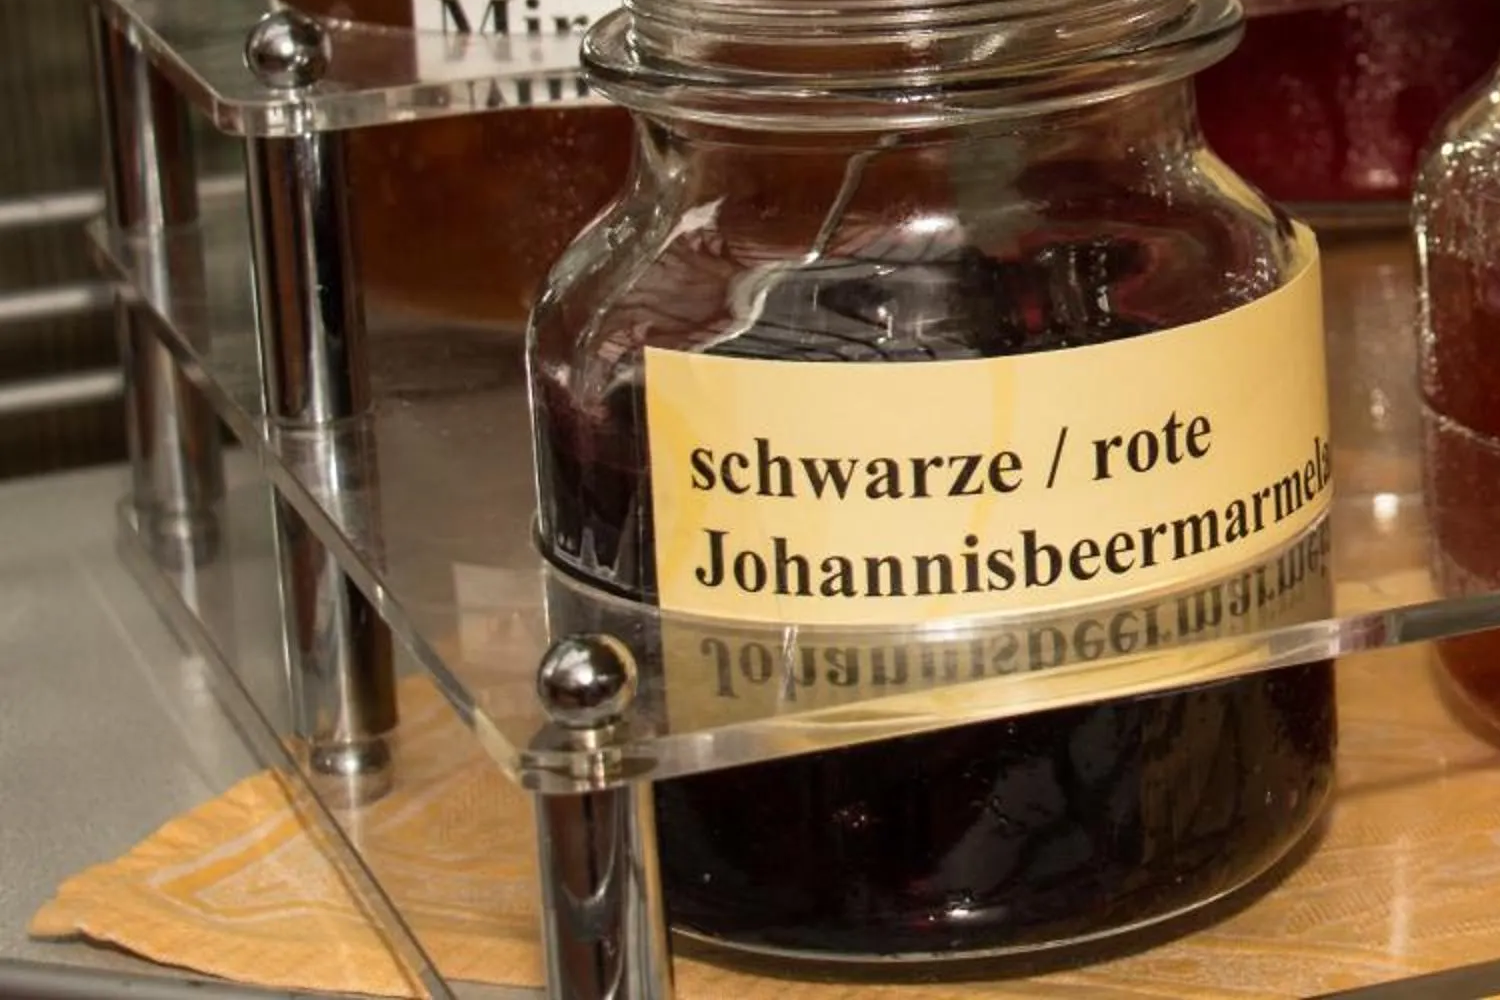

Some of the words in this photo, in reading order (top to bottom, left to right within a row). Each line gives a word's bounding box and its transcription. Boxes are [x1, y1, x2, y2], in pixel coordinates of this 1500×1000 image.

[690, 437, 1024, 501] schwarze
[1044, 426, 1069, 489] /
[1092, 410, 1213, 482] rote
